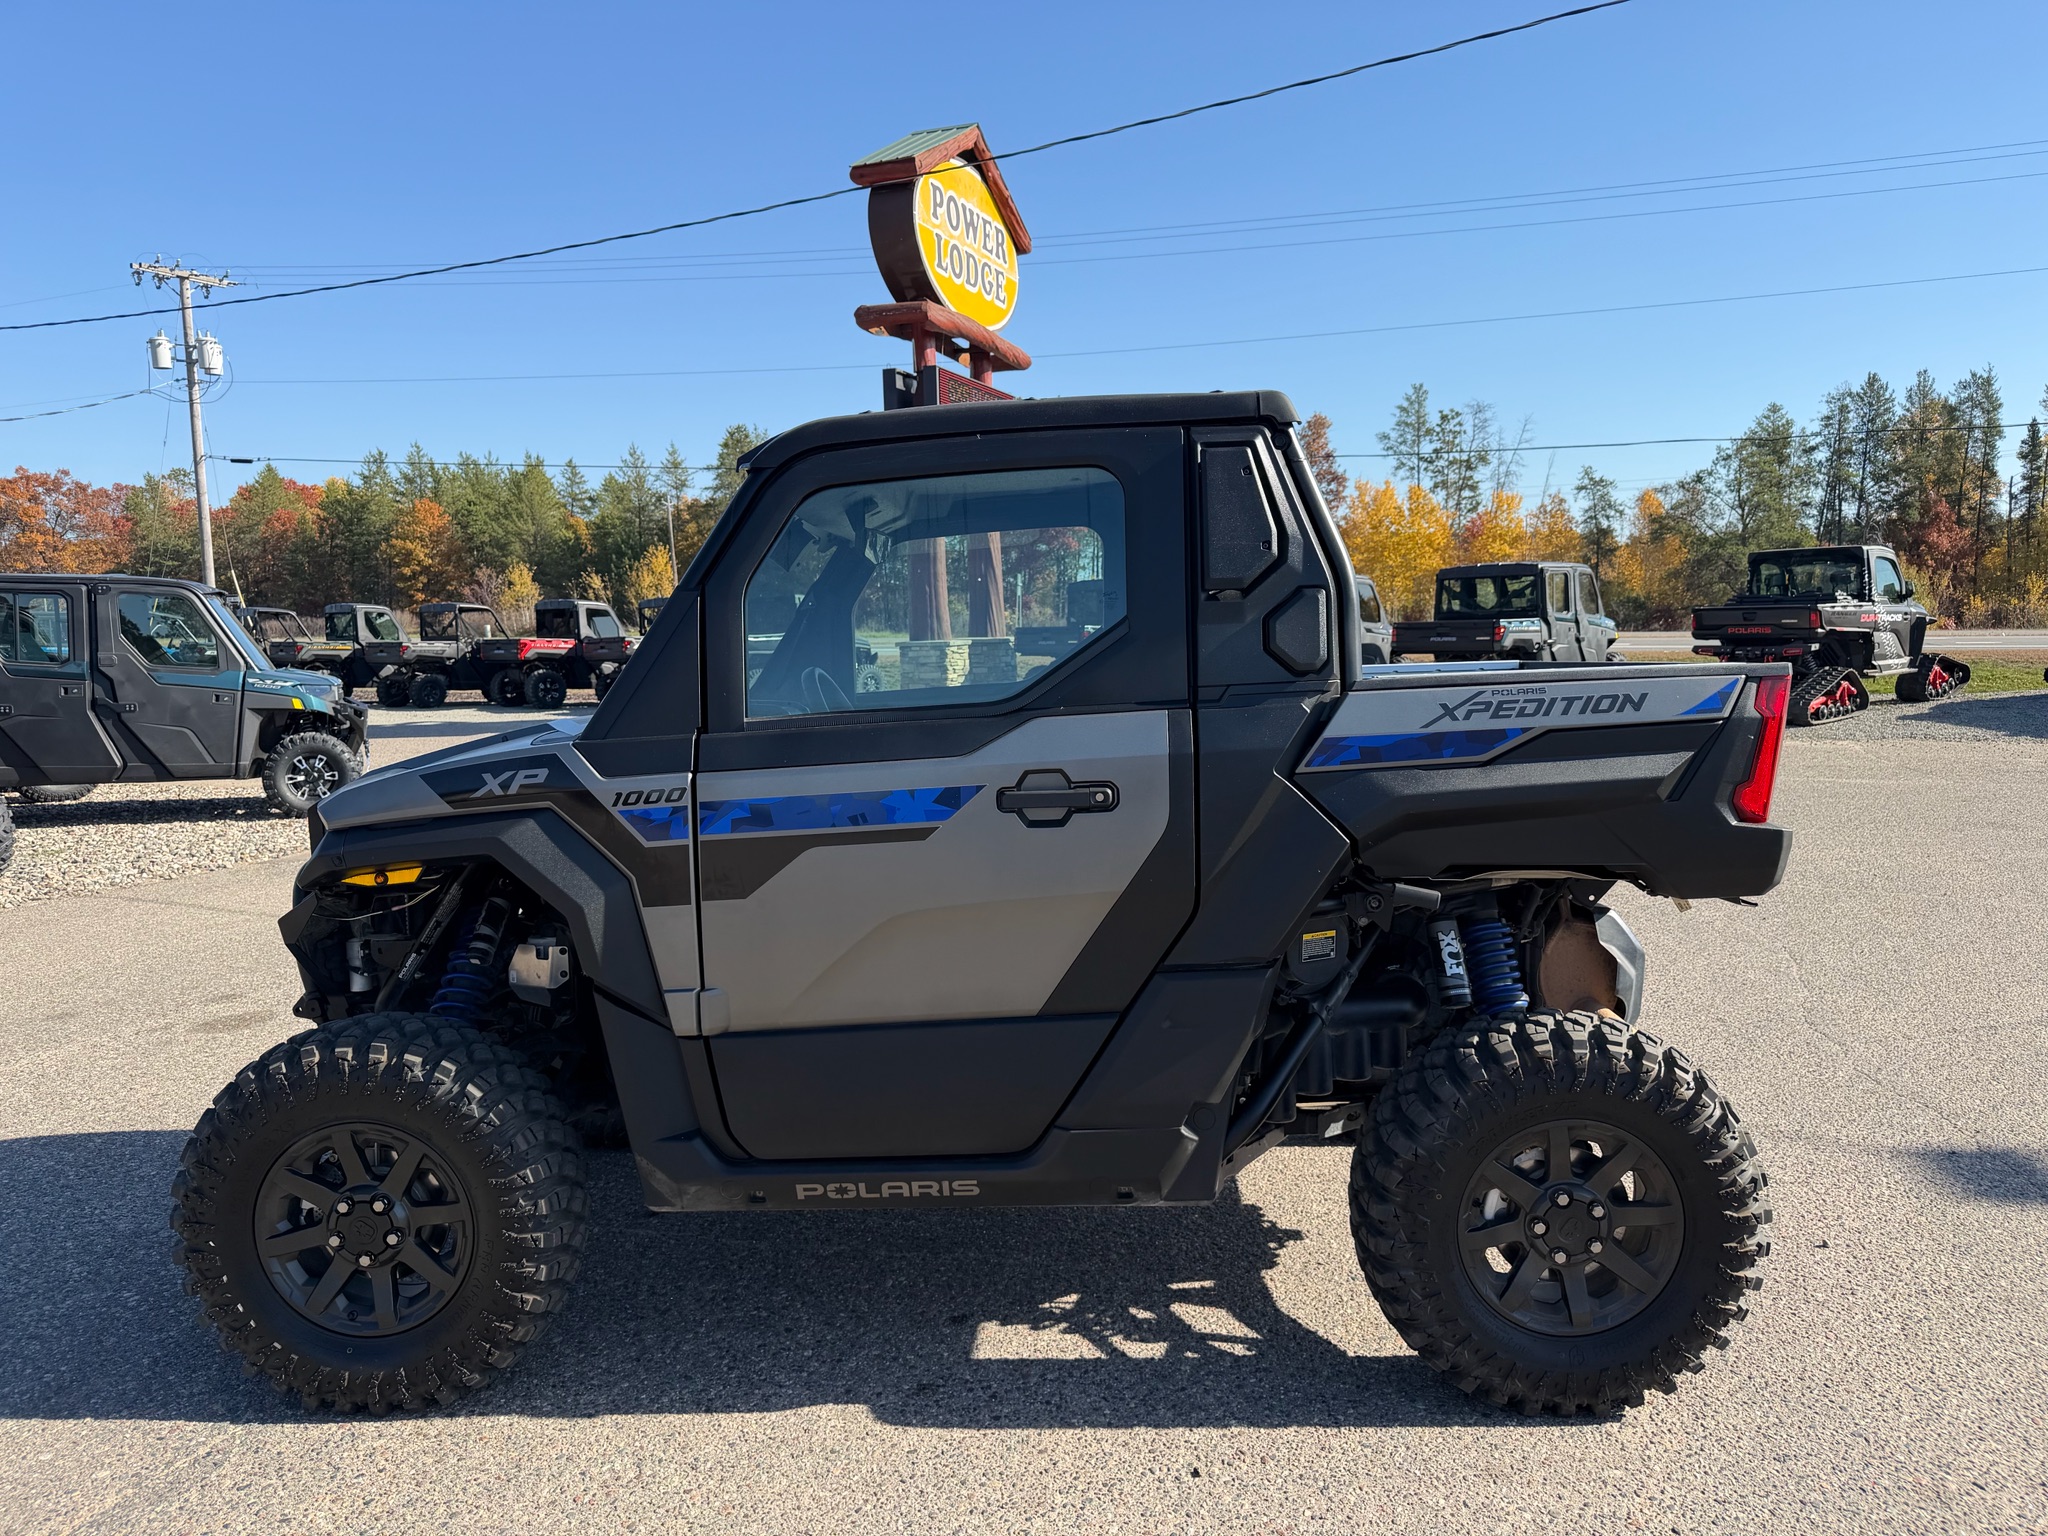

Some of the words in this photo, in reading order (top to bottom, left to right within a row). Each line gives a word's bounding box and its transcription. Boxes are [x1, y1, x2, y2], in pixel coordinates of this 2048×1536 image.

[930, 181, 1008, 265] POWER
[935, 232, 1006, 305] LODGE
[1727, 626, 1772, 634] POLARIS
[1490, 686, 1548, 697] POLARIS
[1418, 690, 1649, 729] XPEDITION
[470, 767, 550, 798] XP
[611, 786, 688, 808] 1000
[1437, 930, 1464, 977] FOX
[795, 1180, 981, 1200] POLARIS
